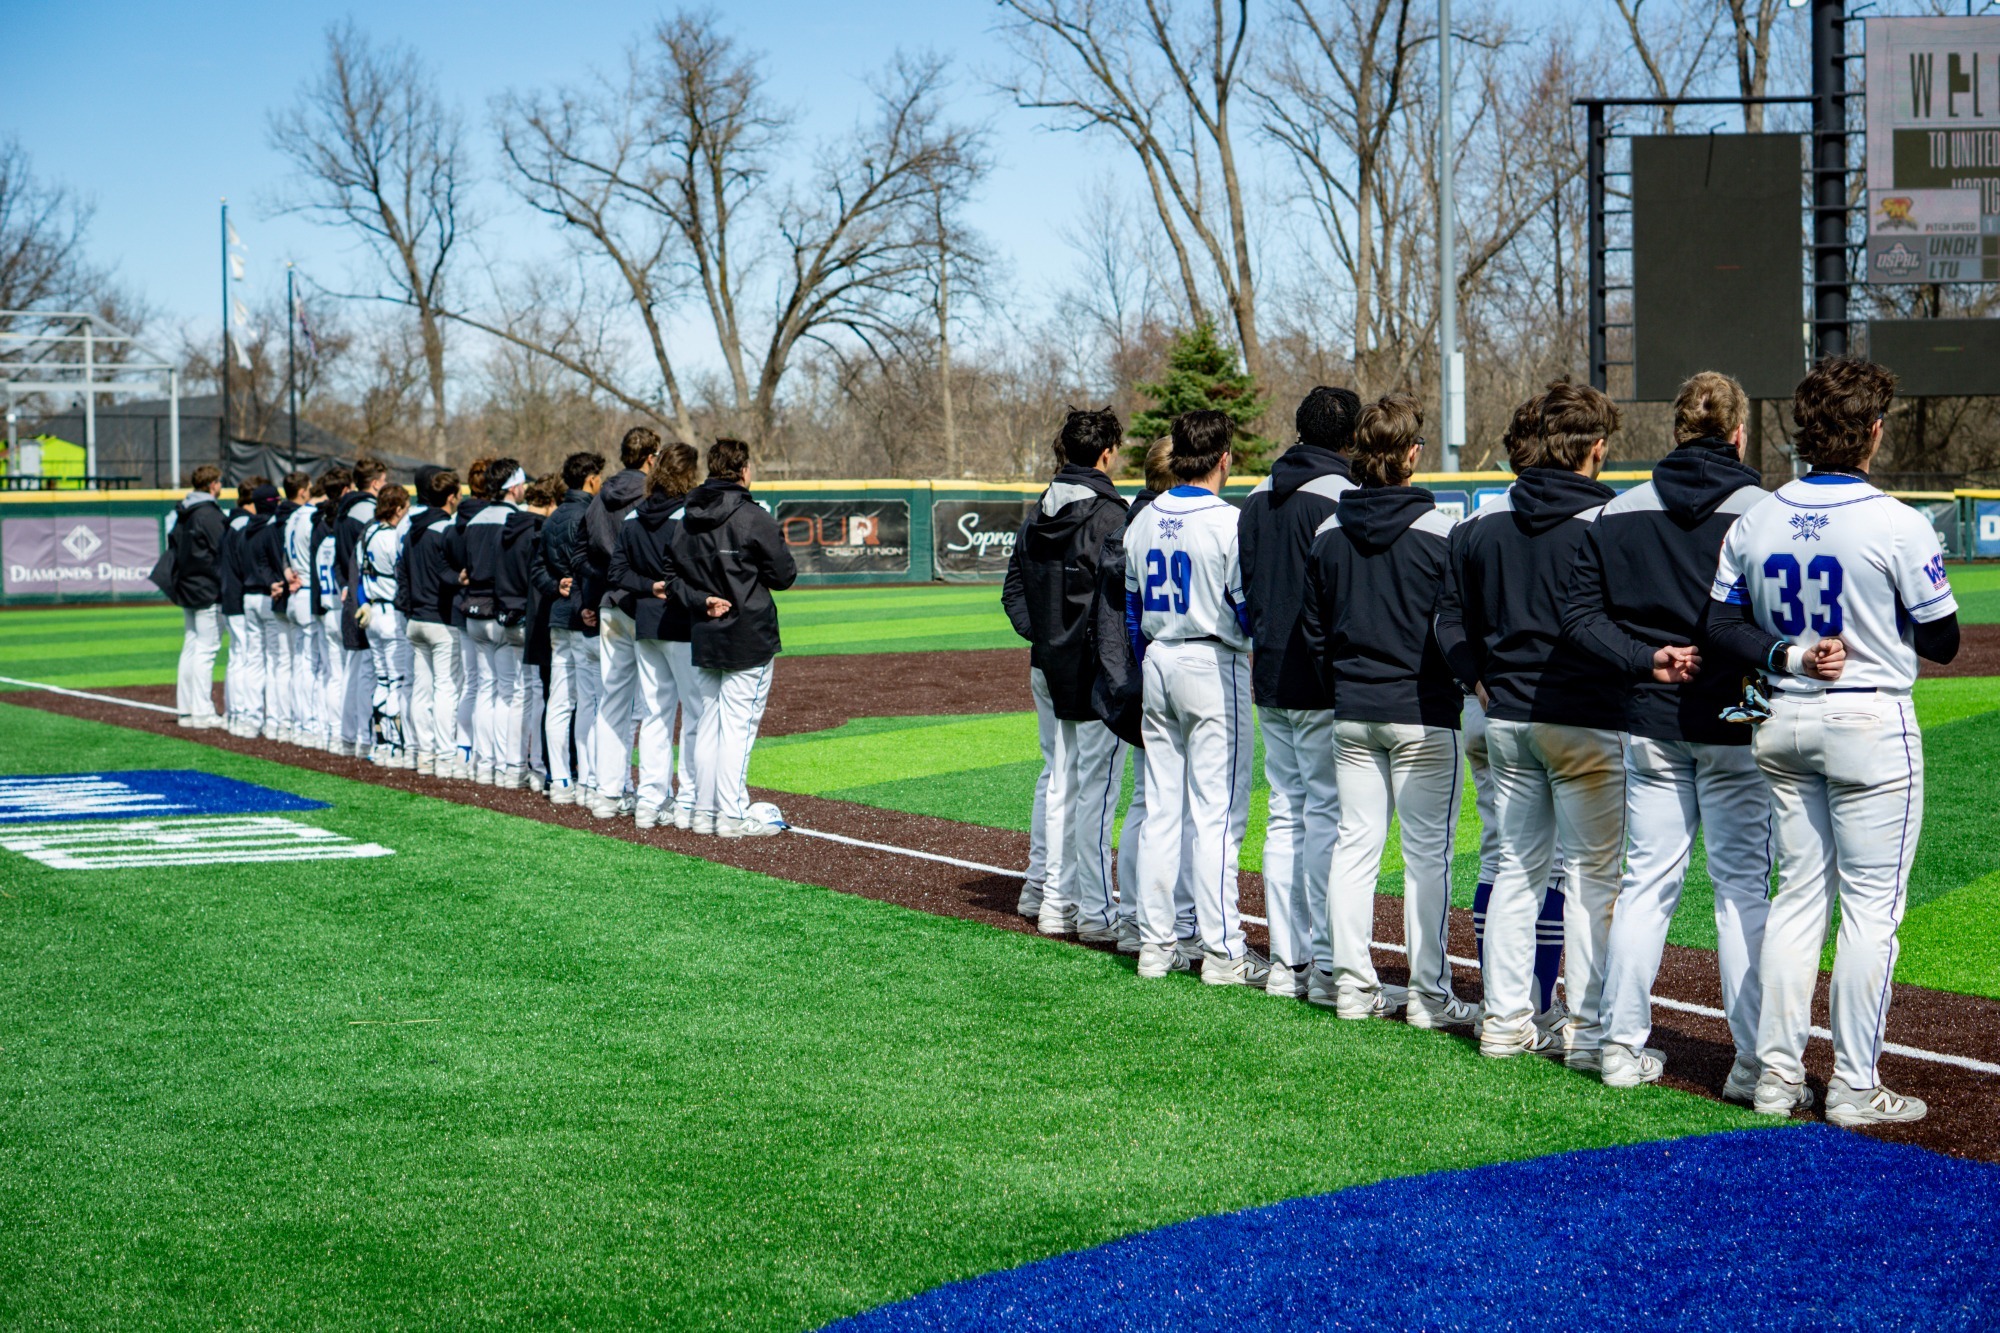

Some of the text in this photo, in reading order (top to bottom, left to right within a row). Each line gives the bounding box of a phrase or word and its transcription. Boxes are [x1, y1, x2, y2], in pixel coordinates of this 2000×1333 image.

[1928, 130, 2000, 168] TO UNITED
[1925, 222, 1950, 232] PITCH
[1952, 222, 1977, 232] SPEED
[1929, 261, 1960, 279] LTU
[825, 547, 903, 557] CREDIT UNION
[1144, 549, 1192, 615] 29
[1763, 553, 1844, 637] 33
